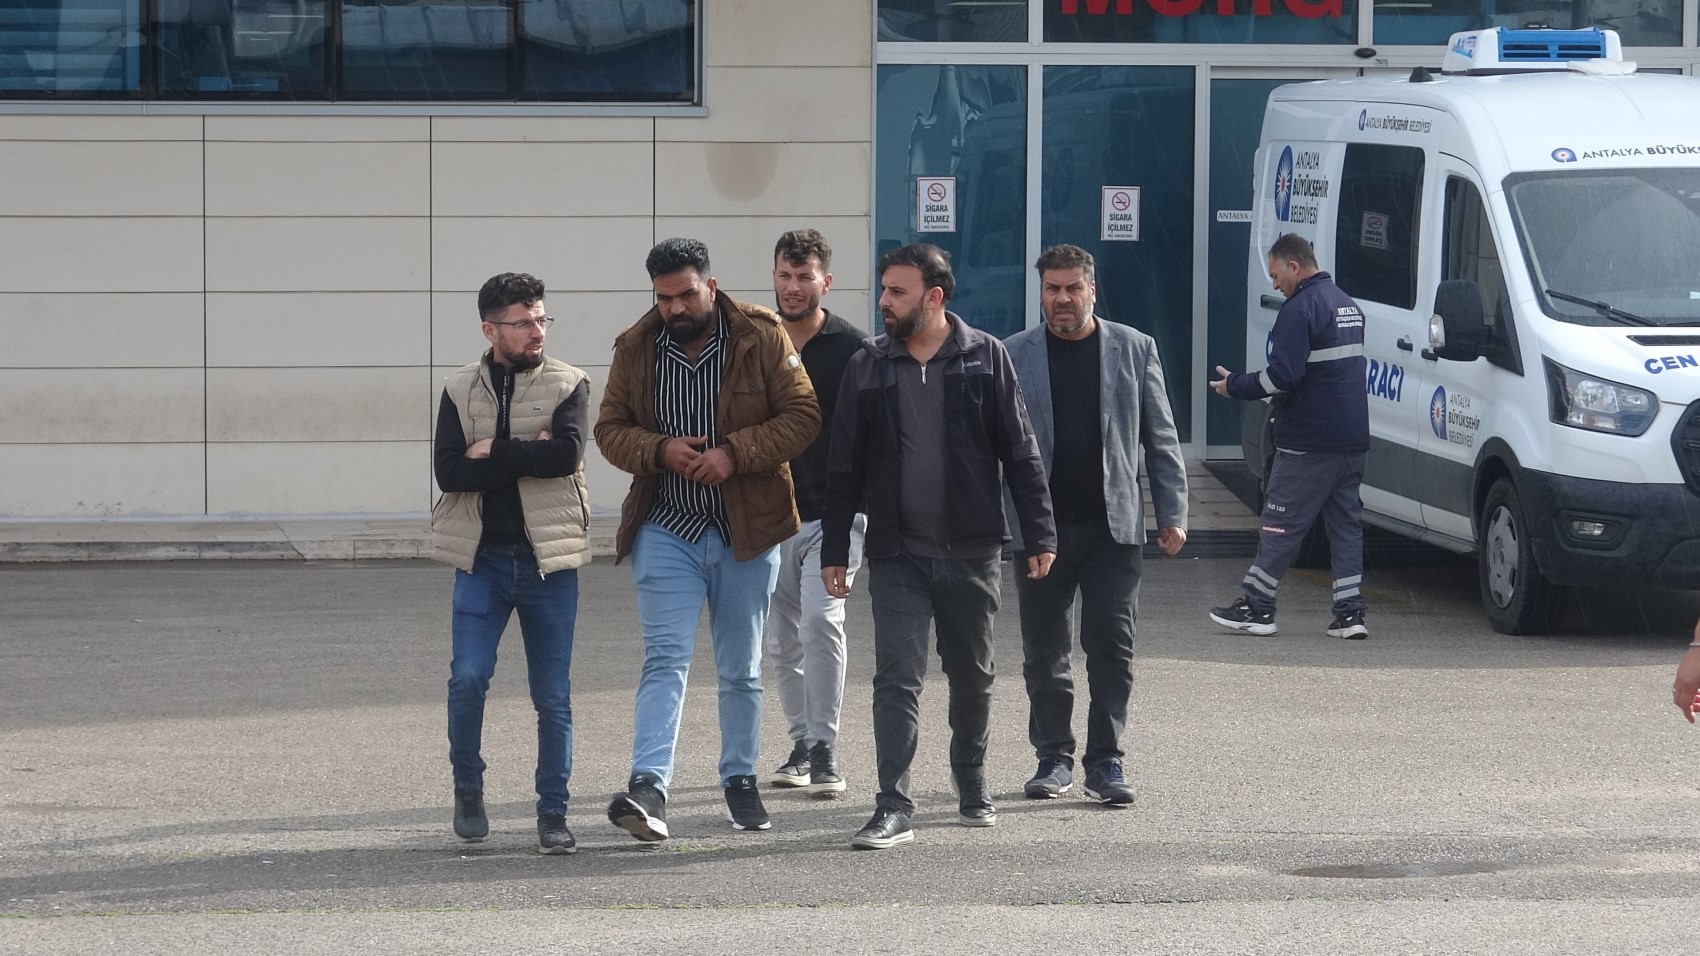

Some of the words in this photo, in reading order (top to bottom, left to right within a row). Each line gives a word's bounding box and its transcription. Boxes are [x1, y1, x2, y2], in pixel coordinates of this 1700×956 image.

[1295, 151, 1320, 170] ANTALYA
[1582, 148, 1643, 160] ANTALYA
[1646, 144, 1700, 155] BÜYÜK
[1293, 174, 1328, 201] BÜYÜKŞEHİR
[925, 203, 949, 213] SİGARA
[1109, 212, 1132, 221] SİGARA
[1218, 212, 1249, 220] ANTALYA
[1290, 202, 1318, 225] BELEDİYESİ
[923, 213, 950, 224] İÇİLMEZ
[1107, 222, 1133, 233] İÇİLMEZ
[1644, 354, 1699, 375] CEN
[1449, 393, 1471, 410] ANTALYA
[1448, 409, 1480, 431] BÜYÜKŞEHİR
[1449, 430, 1474, 448] BELEDİYESİ
